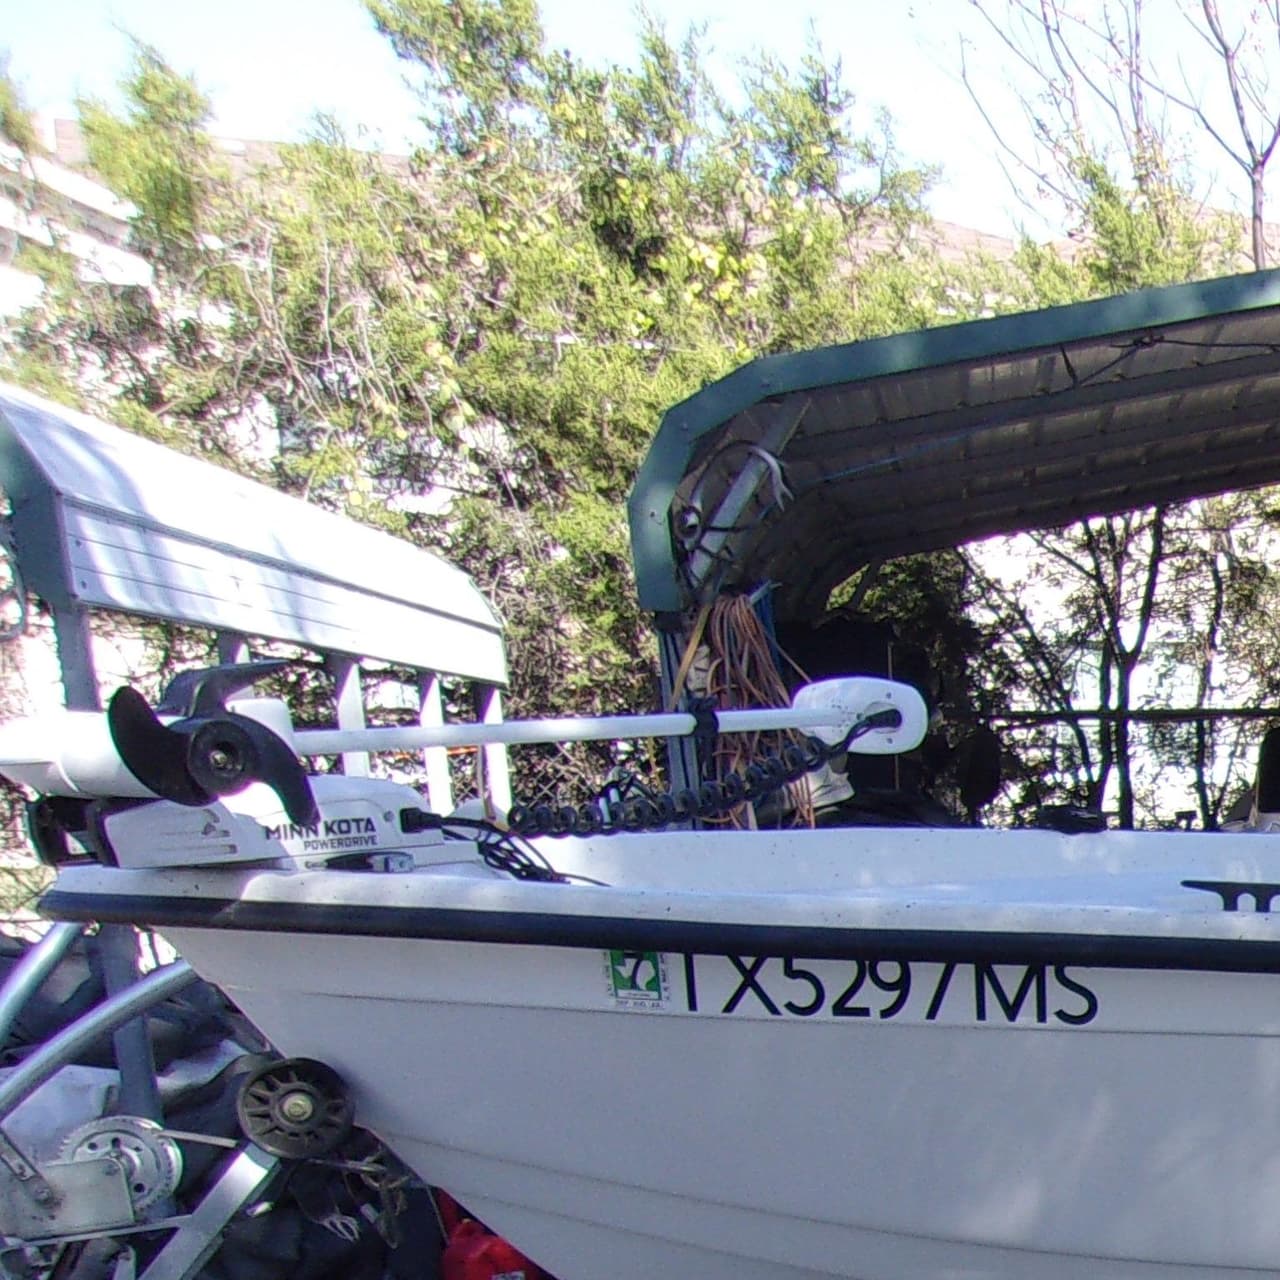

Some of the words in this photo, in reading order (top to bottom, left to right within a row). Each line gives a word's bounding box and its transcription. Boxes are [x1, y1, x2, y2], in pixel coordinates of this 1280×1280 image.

[265, 824, 319, 840] MINN
[324, 818, 376, 836] KOTA
[304, 836, 377, 851] POWERDRIVE
